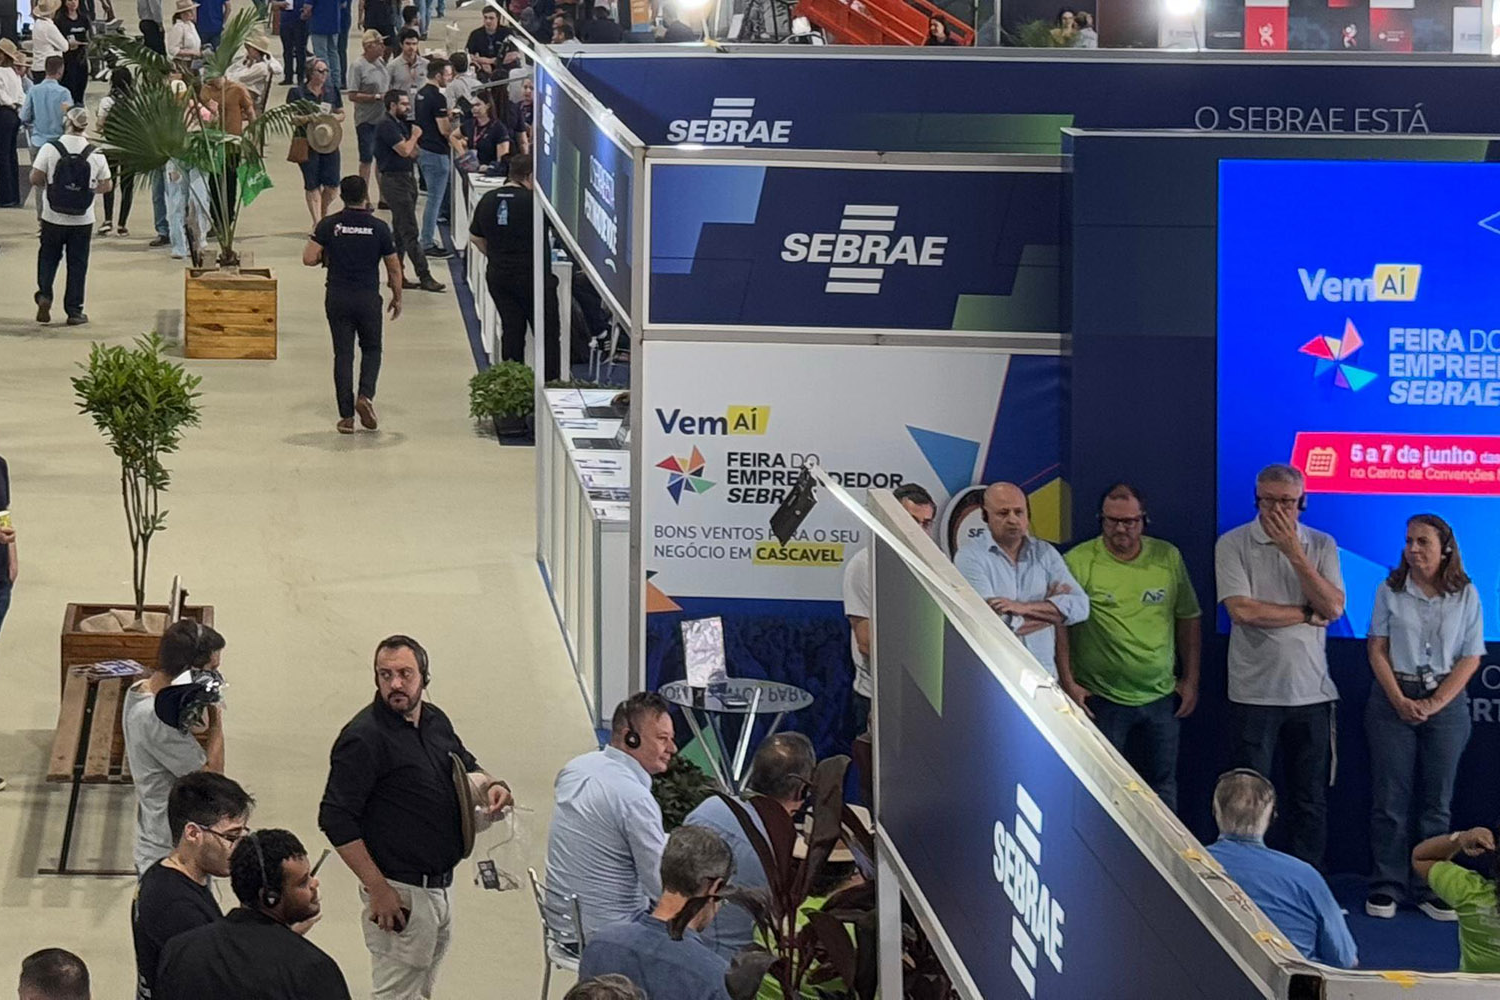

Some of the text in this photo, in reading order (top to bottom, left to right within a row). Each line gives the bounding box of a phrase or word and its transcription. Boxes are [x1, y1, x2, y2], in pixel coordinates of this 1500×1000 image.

[666, 118, 793, 144] SEBRAE
[1194, 102, 1430, 134] O SEBRAE ESTÁ
[780, 232, 949, 267] SEBRAE
[1297, 266, 1406, 302] Vem AÍ
[1388, 327, 1465, 352] FEIRA
[1388, 353, 1500, 380] EMPREE
[1387, 380, 1500, 407] SEBRAE
[655, 407, 758, 435] Vem AÍ
[727, 451, 786, 468] FEIRA
[1365, 448, 1380, 464] a
[1381, 445, 1393, 464] 7
[1396, 445, 1421, 464] de
[1422, 445, 1477, 468] junho
[1368, 467, 1406, 480] Centro
[1425, 468, 1495, 483] Convenções
[727, 488, 787, 505] SEBR
[654, 525, 860, 544] BONS VENTOS PRA O SEU
[654, 542, 844, 563] NEGÓCIO EM CASCAVEL.
[992, 819, 1066, 974] SEBRAE
